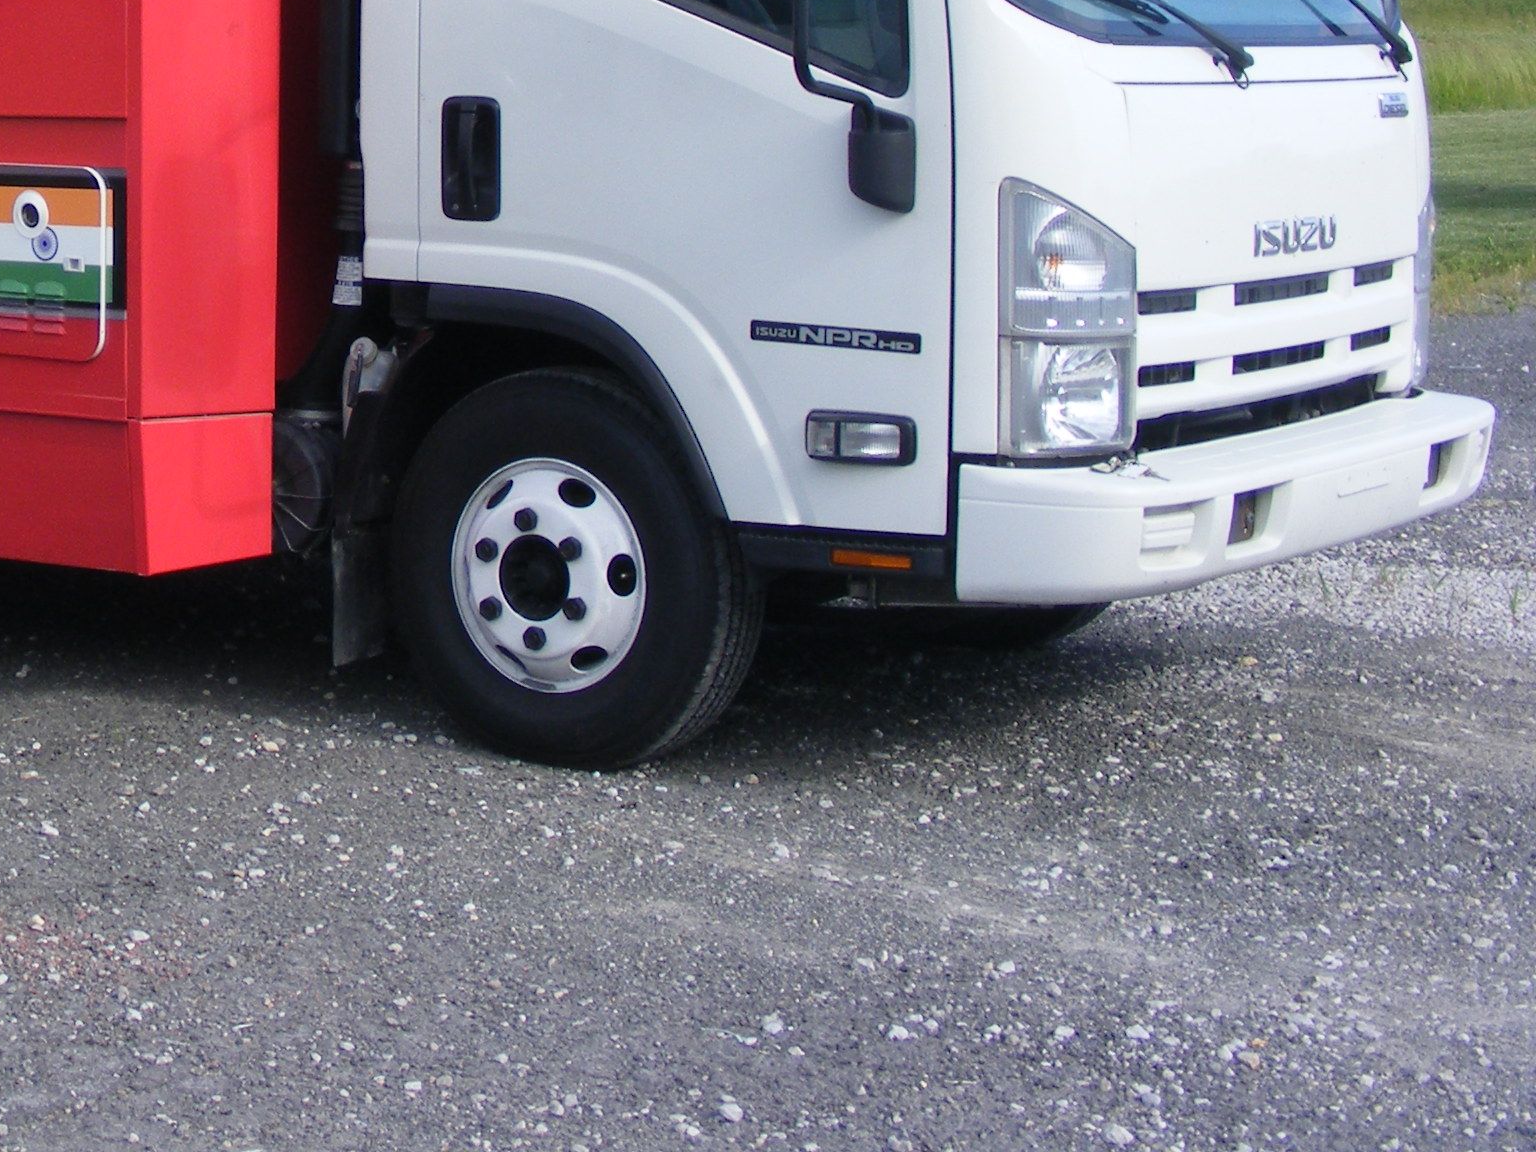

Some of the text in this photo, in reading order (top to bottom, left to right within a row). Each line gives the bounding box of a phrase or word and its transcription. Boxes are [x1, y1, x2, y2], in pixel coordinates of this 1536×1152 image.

[1252, 215, 1337, 258] ISUZU
[755, 325, 915, 352] ISUZU NPR HD
